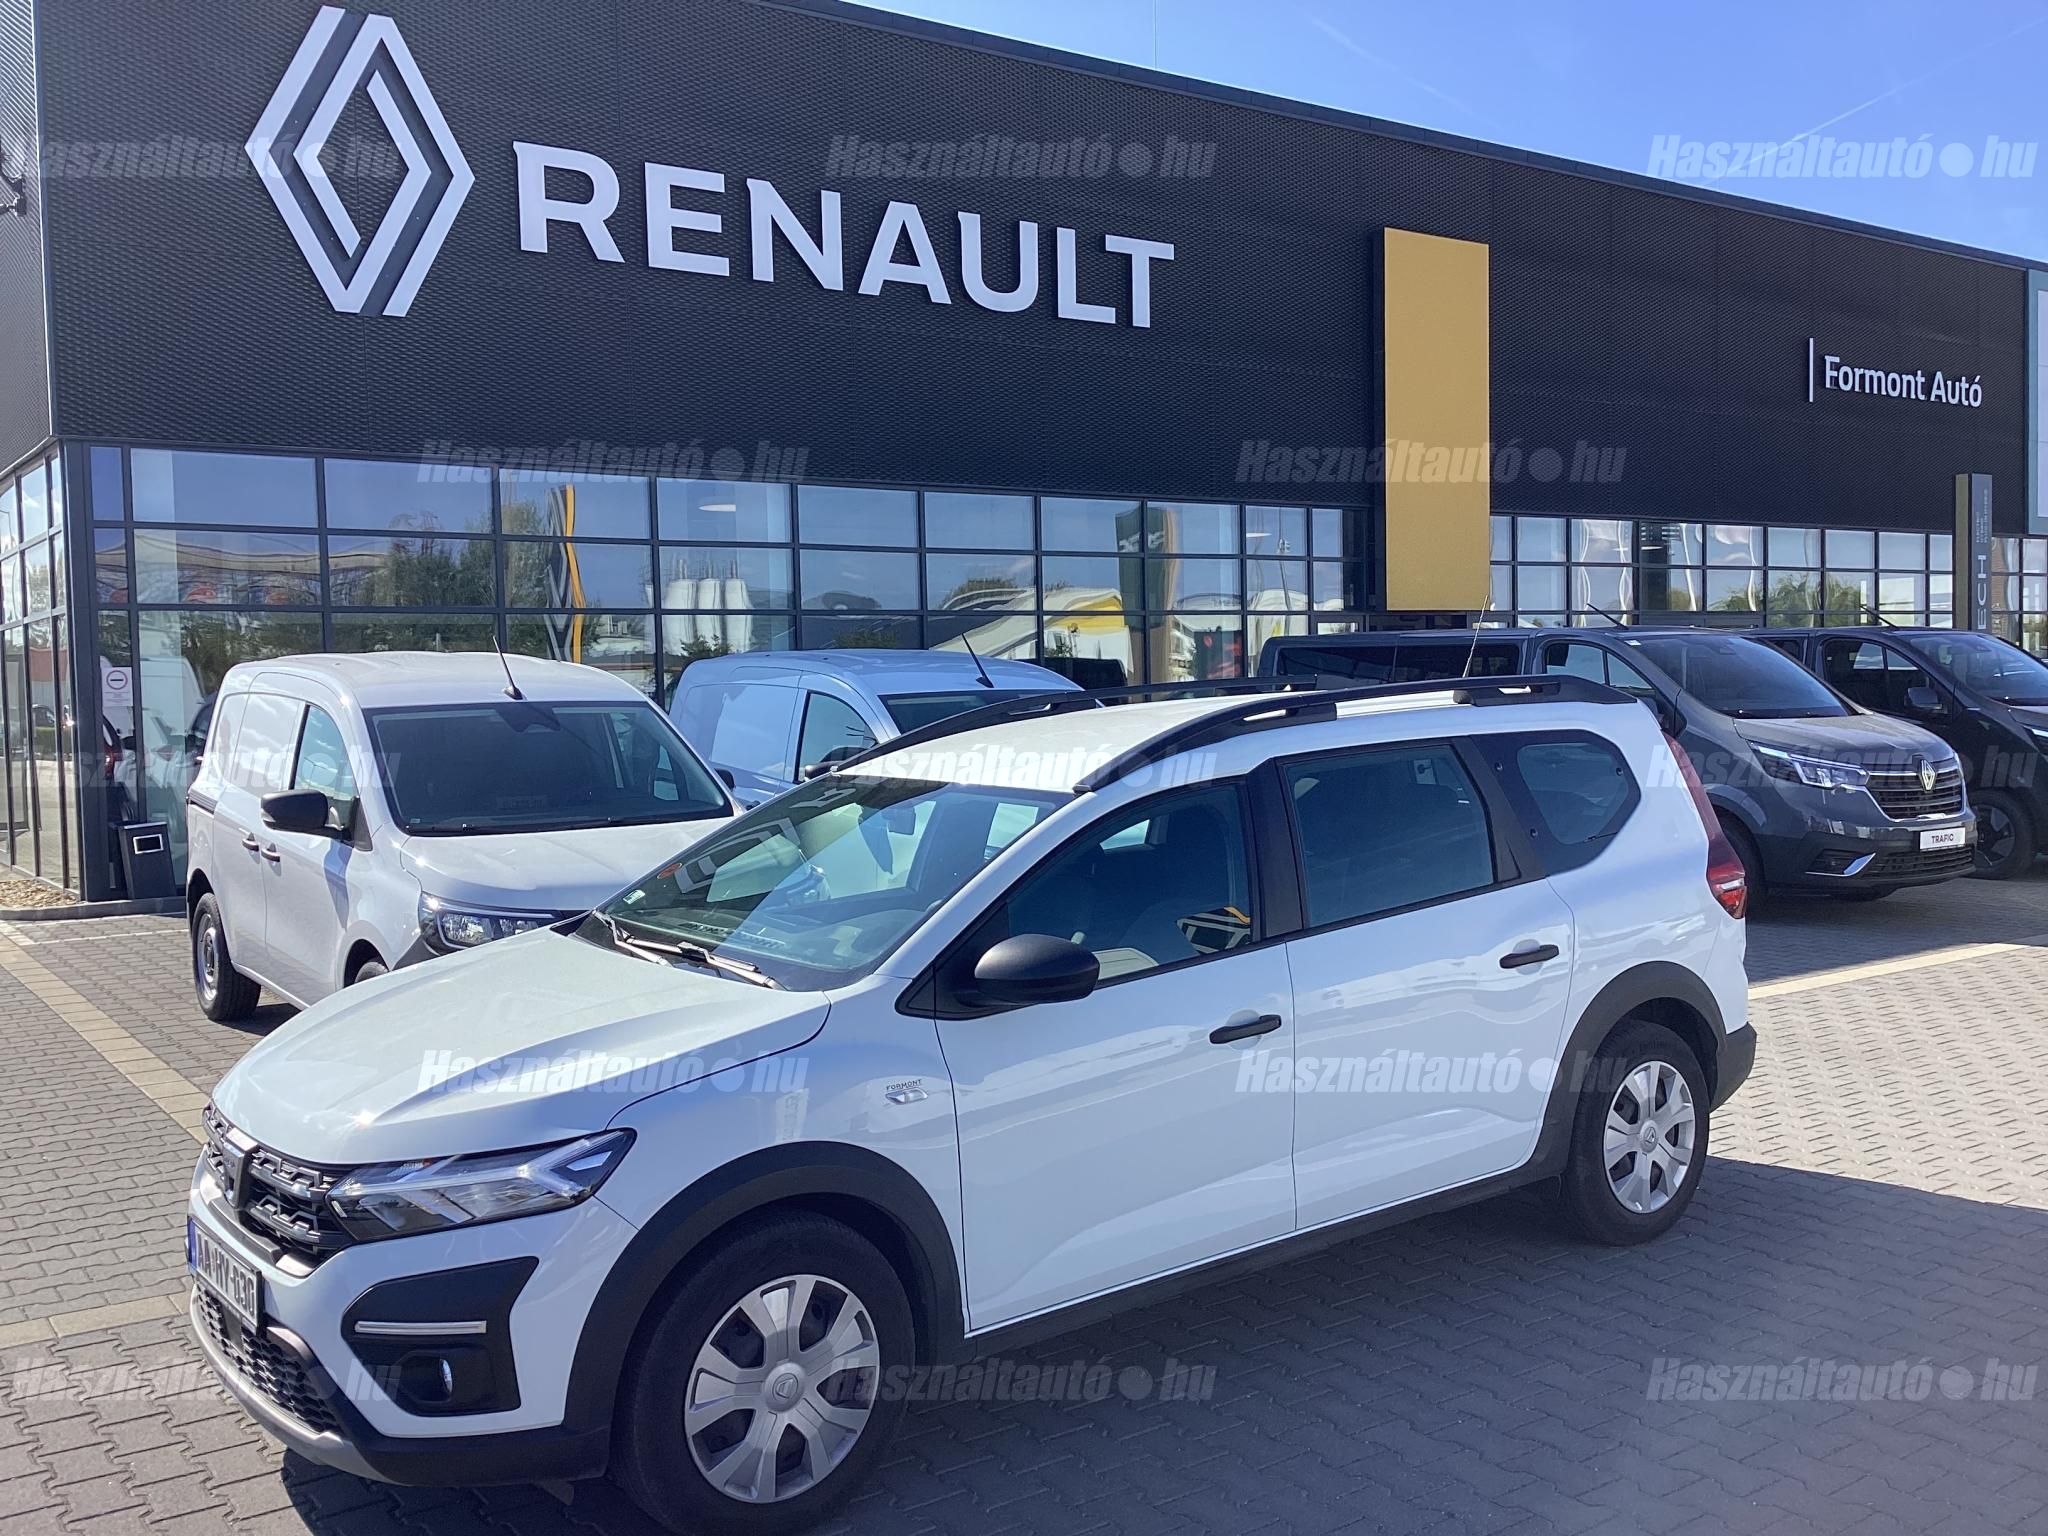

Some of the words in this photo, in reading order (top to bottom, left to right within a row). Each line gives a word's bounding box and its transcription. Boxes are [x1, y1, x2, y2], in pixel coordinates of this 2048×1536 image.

[512, 140, 1175, 329] RENAULT
[1824, 355, 1927, 400] Formont
[1930, 370, 1983, 408] Autó
[1931, 833, 1954, 844] TRAFIC
